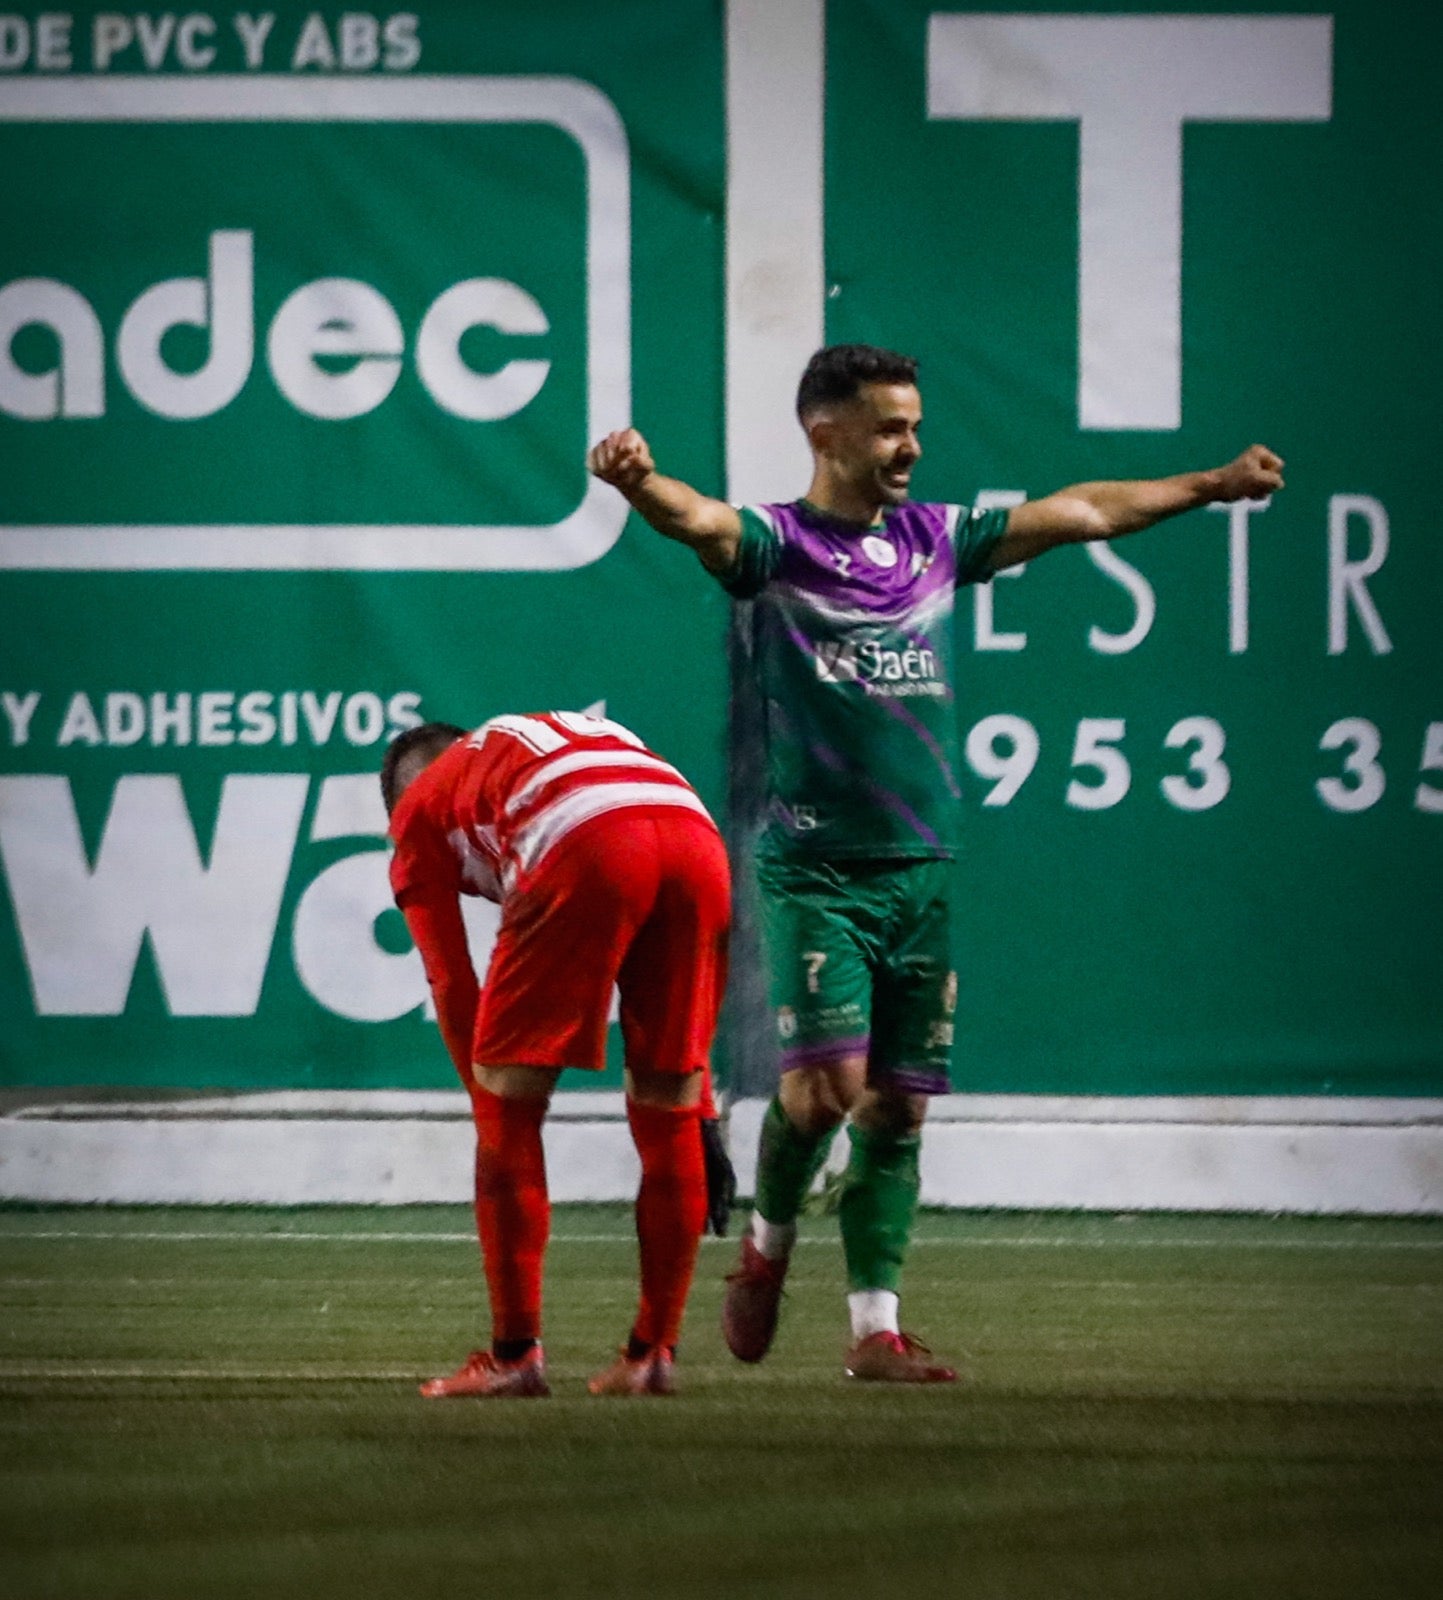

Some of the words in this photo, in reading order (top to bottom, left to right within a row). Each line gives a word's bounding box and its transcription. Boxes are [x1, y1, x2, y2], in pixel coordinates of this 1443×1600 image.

[0, 14, 71, 68] DE
[94, 14, 216, 69] PVC
[236, 14, 274, 67] Y
[293, 13, 421, 70] ABS
[926, 13, 1333, 431] T
[0, 229, 552, 422] adec
[2, 692, 41, 746] Y
[57, 690, 424, 747] ADHESIVOS
[965, 713, 1231, 812] 953
[803, 951, 828, 992] 7
